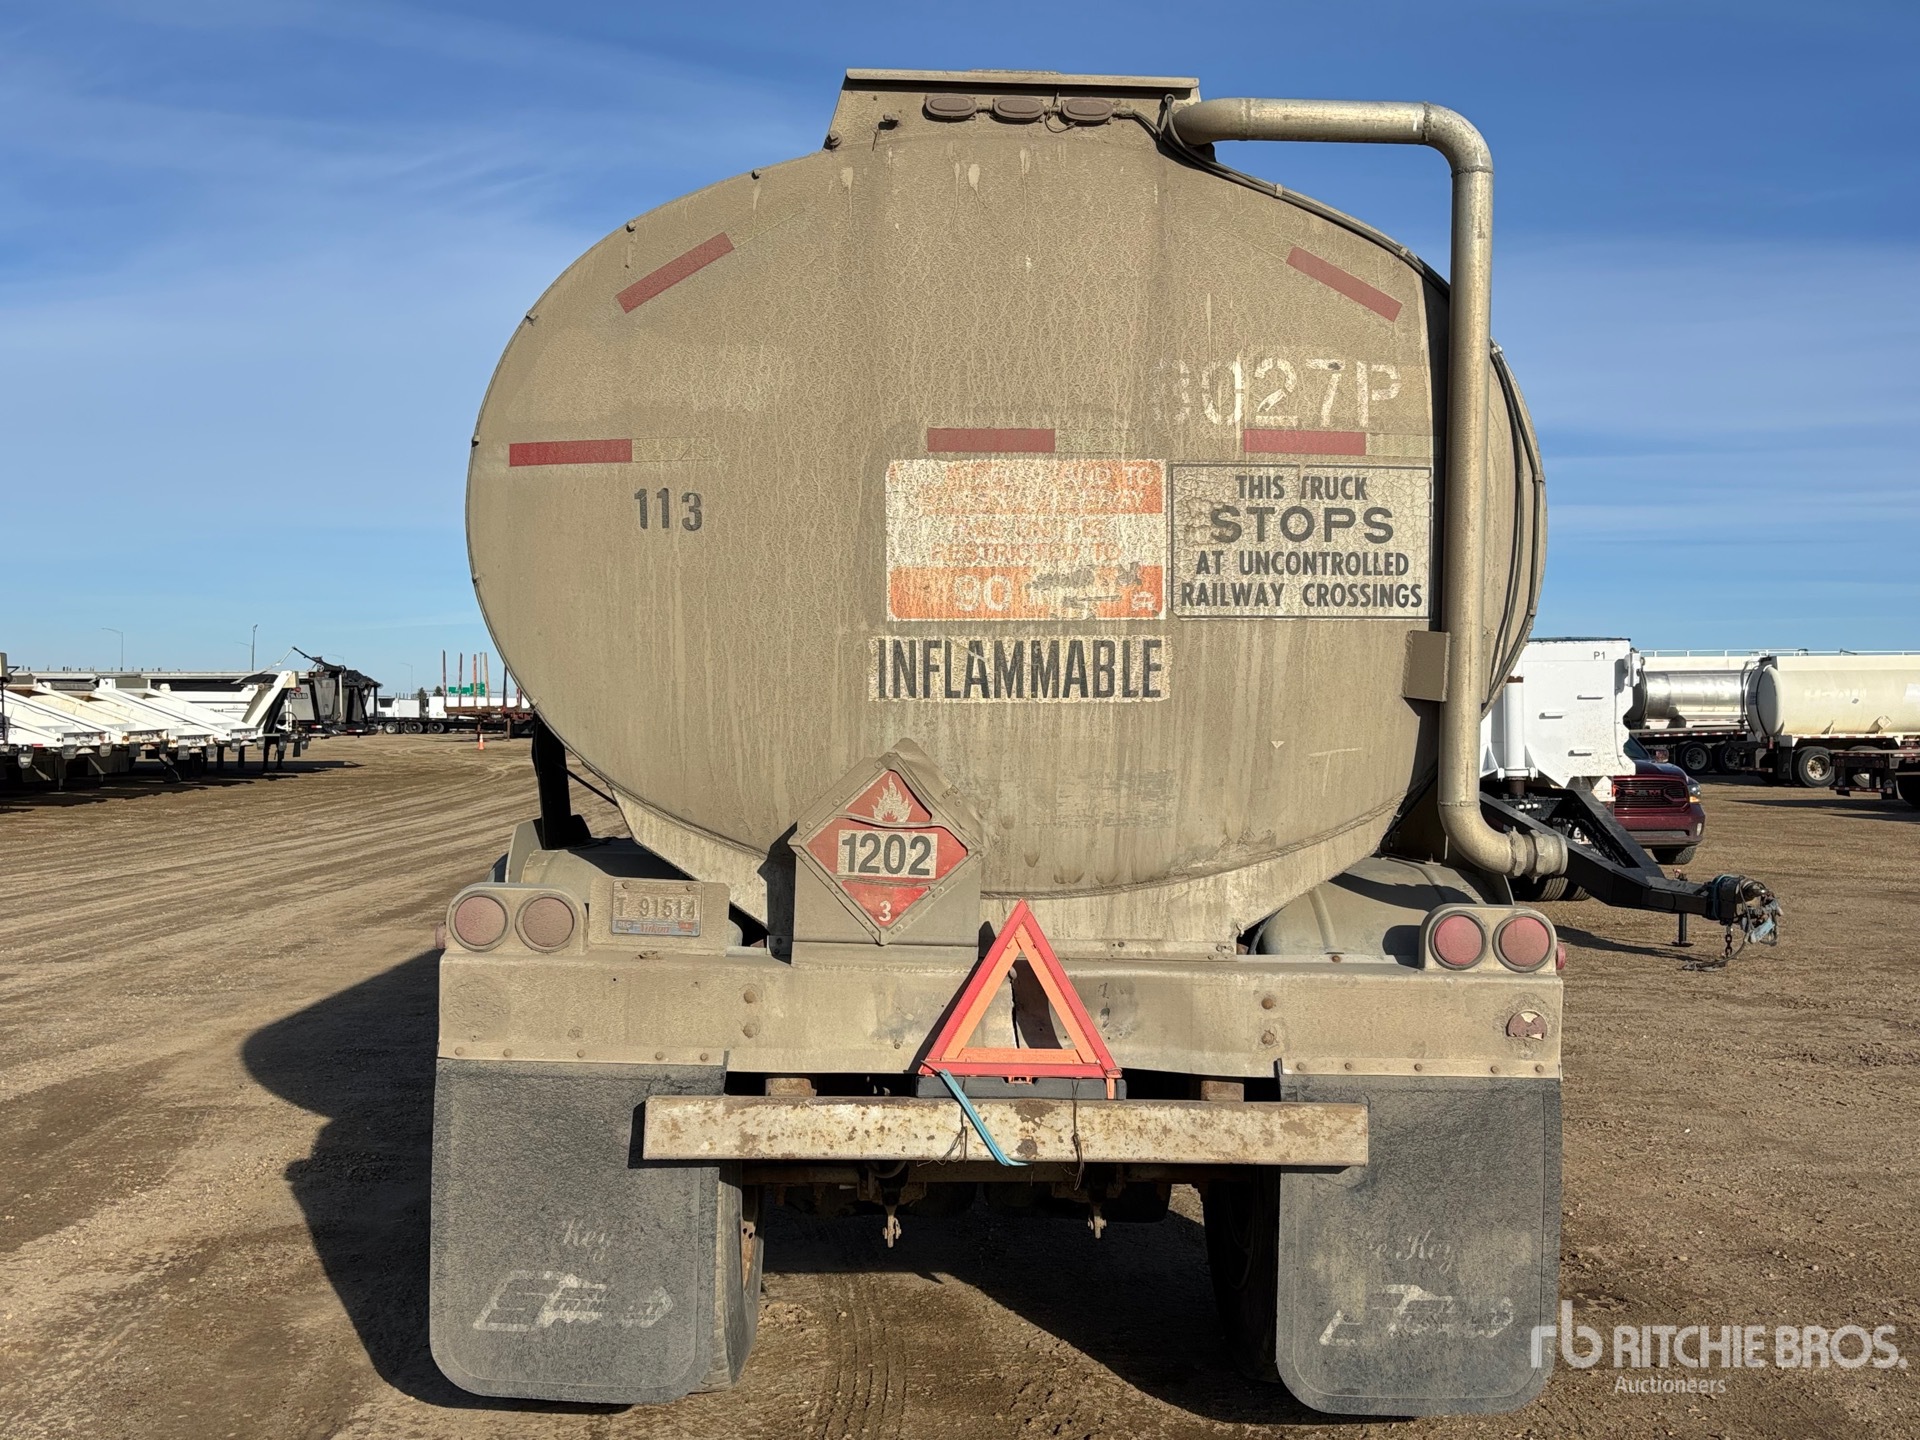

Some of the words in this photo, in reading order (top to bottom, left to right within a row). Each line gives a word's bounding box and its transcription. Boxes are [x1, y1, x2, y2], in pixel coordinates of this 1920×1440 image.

[1235, 475, 1284, 500] THIS
[1300, 476, 1368, 500] TRUCK
[634, 487, 702, 531] 113
[1210, 505, 1394, 544] STOPS
[1196, 550, 1224, 575] AT
[1239, 551, 1410, 576] UNCONTROLLED
[951, 574, 1013, 613] 90
[1181, 582, 1285, 607] RAILWAY
[1302, 583, 1422, 608] CROSSINGS
[1593, 651, 1606, 660] P1
[878, 640, 1161, 699] INFLAMMABLE
[842, 833, 931, 876] 1202
[617, 897, 627, 917] T
[639, 898, 696, 920] 91514
[878, 900, 892, 922] 3
